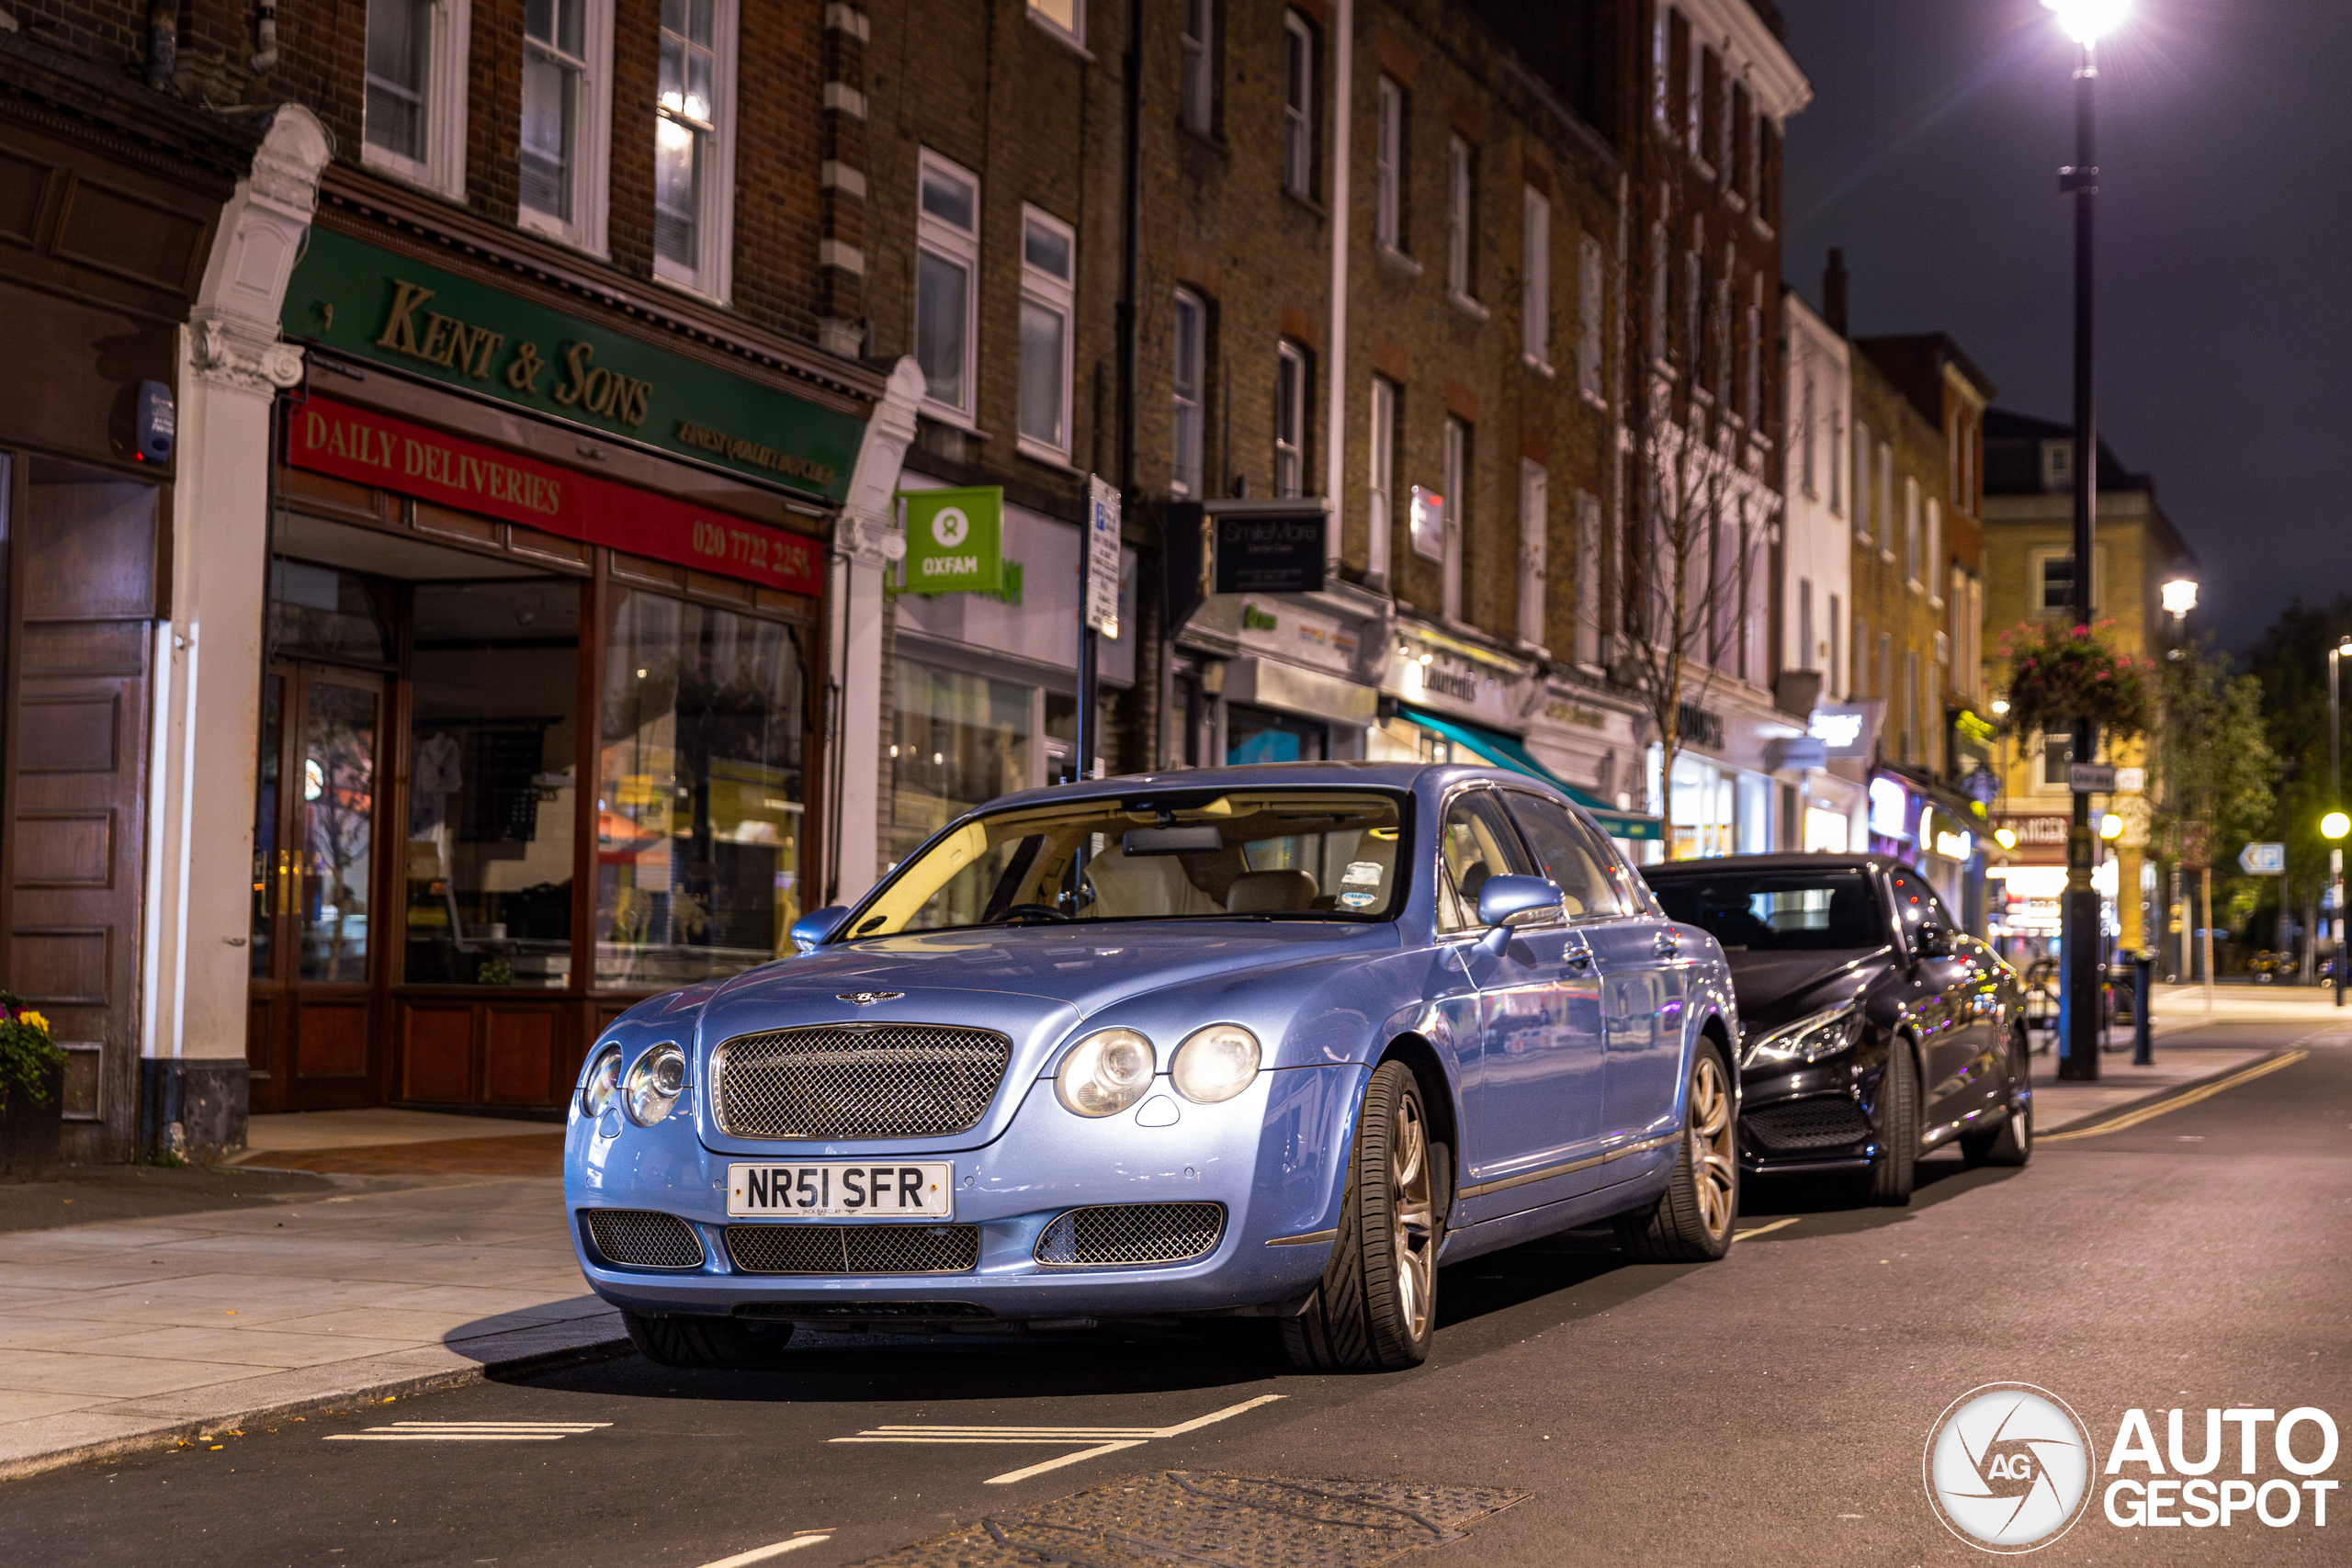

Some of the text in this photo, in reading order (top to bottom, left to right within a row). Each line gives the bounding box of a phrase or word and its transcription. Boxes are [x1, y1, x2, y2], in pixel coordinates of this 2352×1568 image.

[506, 342, 546, 394] &
[306, 411, 561, 516] DAILY DELIVERIES
[693, 519, 726, 558] 020
[922, 556, 978, 577] OXFAM
[748, 1168, 923, 1208] NR51 SFR
